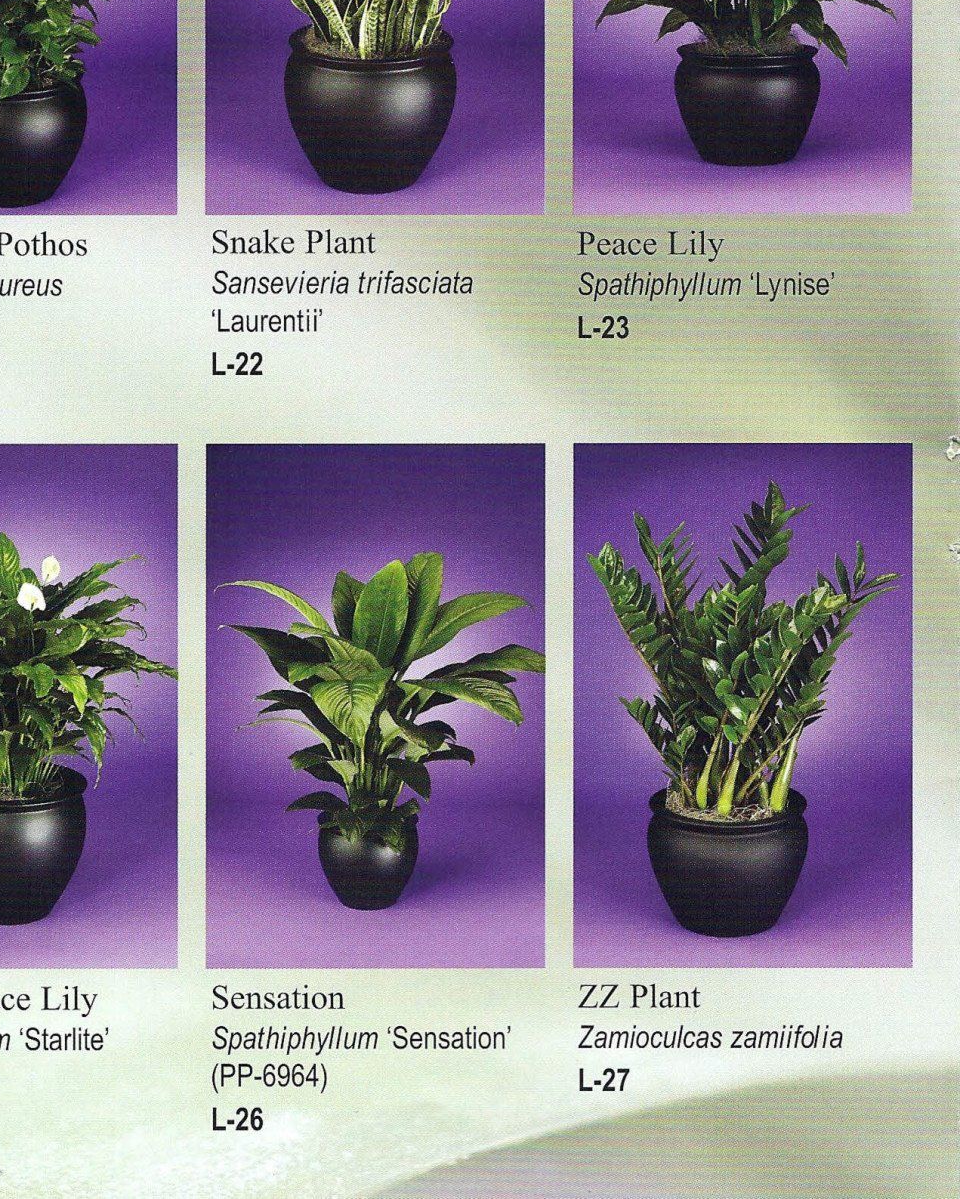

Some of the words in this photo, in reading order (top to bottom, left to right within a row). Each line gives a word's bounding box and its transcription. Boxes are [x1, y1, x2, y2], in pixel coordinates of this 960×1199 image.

[212, 228, 295, 255] Snake
[306, 228, 376, 255] Plant
[578, 231, 657, 256] Peace
[668, 230, 724, 263] Lily
[211, 269, 350, 295] Sansevieria
[358, 270, 473, 295] trifasciata
[578, 271, 742, 303] Spathiphyllum
[750, 271, 835, 303] ‘Lynise’
[211, 308, 323, 333] ‘Laurentii’
[577, 315, 630, 340] L-23
[211, 351, 264, 376] L-22
[42, 985, 98, 1018] Lily
[212, 984, 345, 1010] Sensation
[578, 984, 620, 1009] ZZ
[631, 983, 701, 1009] Plant
[19, 1026, 109, 1052] ‘Starlite’
[212, 1025, 379, 1056] Spathiphyllum
[387, 1025, 511, 1050] ‘Sensation’
[577, 1024, 723, 1049] Zamioculcas
[730, 1024, 844, 1049] zamiifolia
[211, 1063, 328, 1094] (PP-6964)
[578, 1067, 631, 1092] L-27
[212, 1106, 264, 1132] L-26
